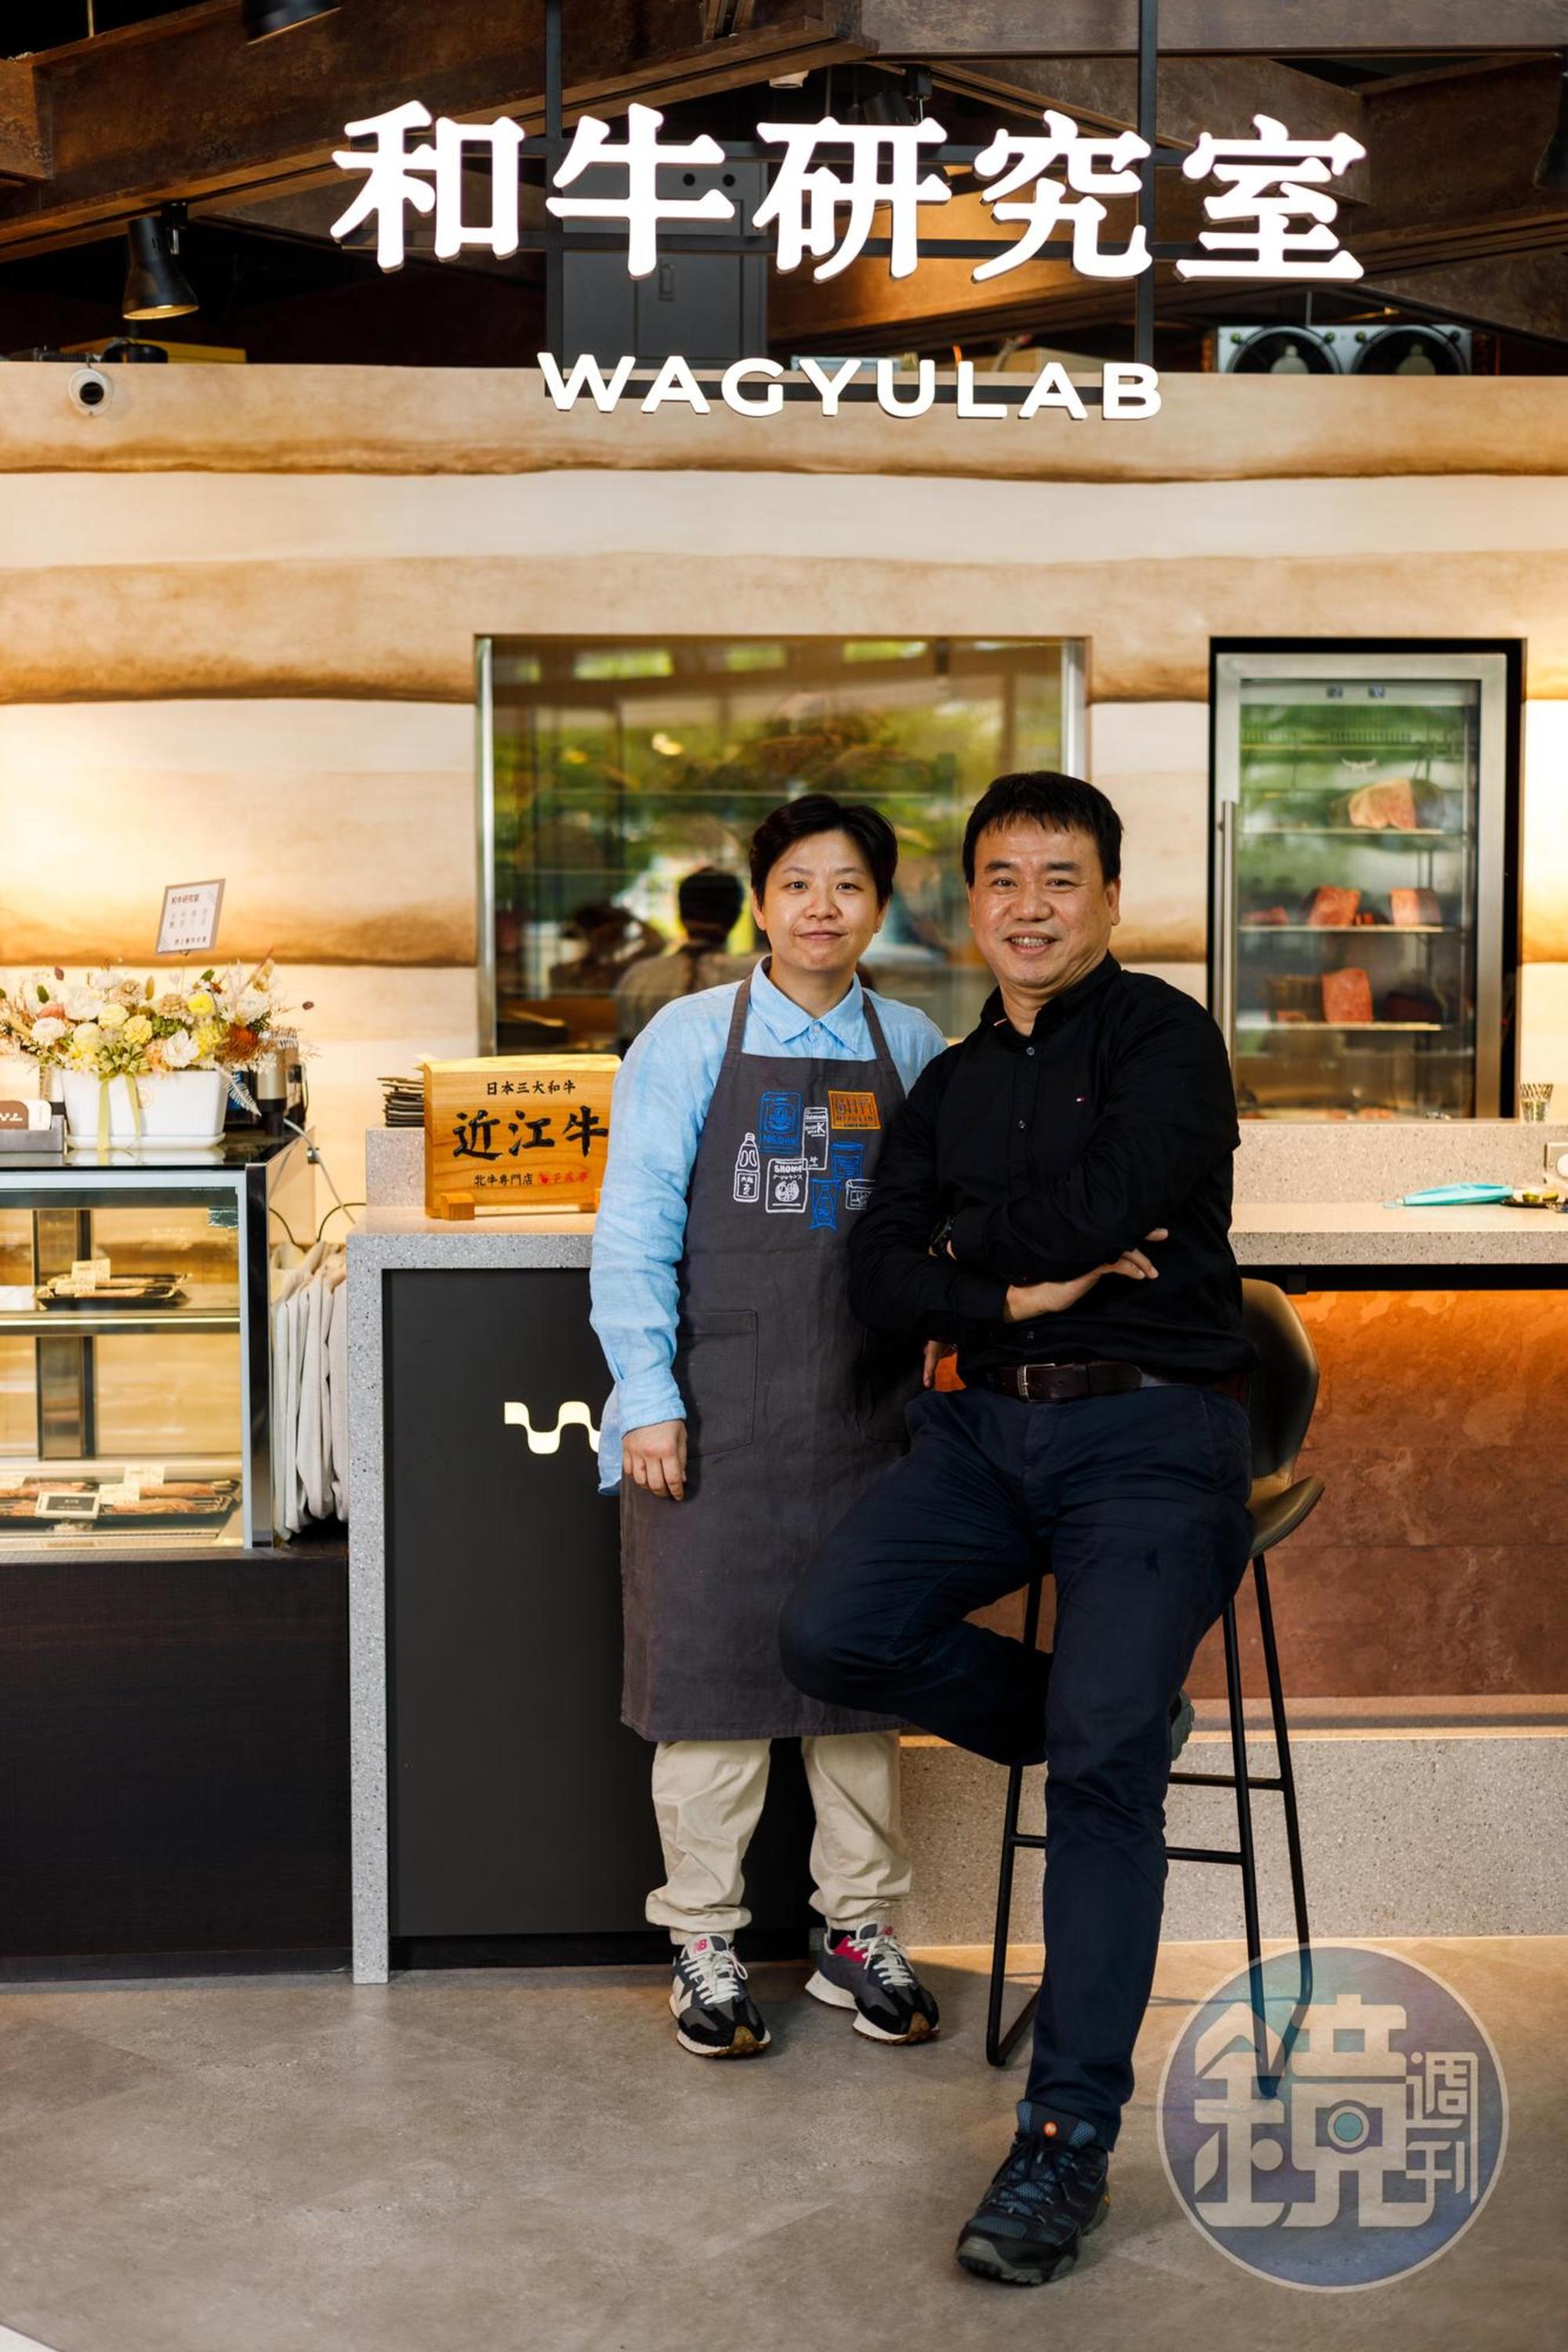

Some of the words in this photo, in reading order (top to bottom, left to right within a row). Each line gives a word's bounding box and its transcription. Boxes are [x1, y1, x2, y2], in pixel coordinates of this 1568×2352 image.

[330, 100, 1367, 283] 和牛研究室
[536, 352, 1162, 420] WAGYULAB
[486, 1079, 576, 1096] 日本三大和牛
[452, 1105, 609, 1161] 近江牛
